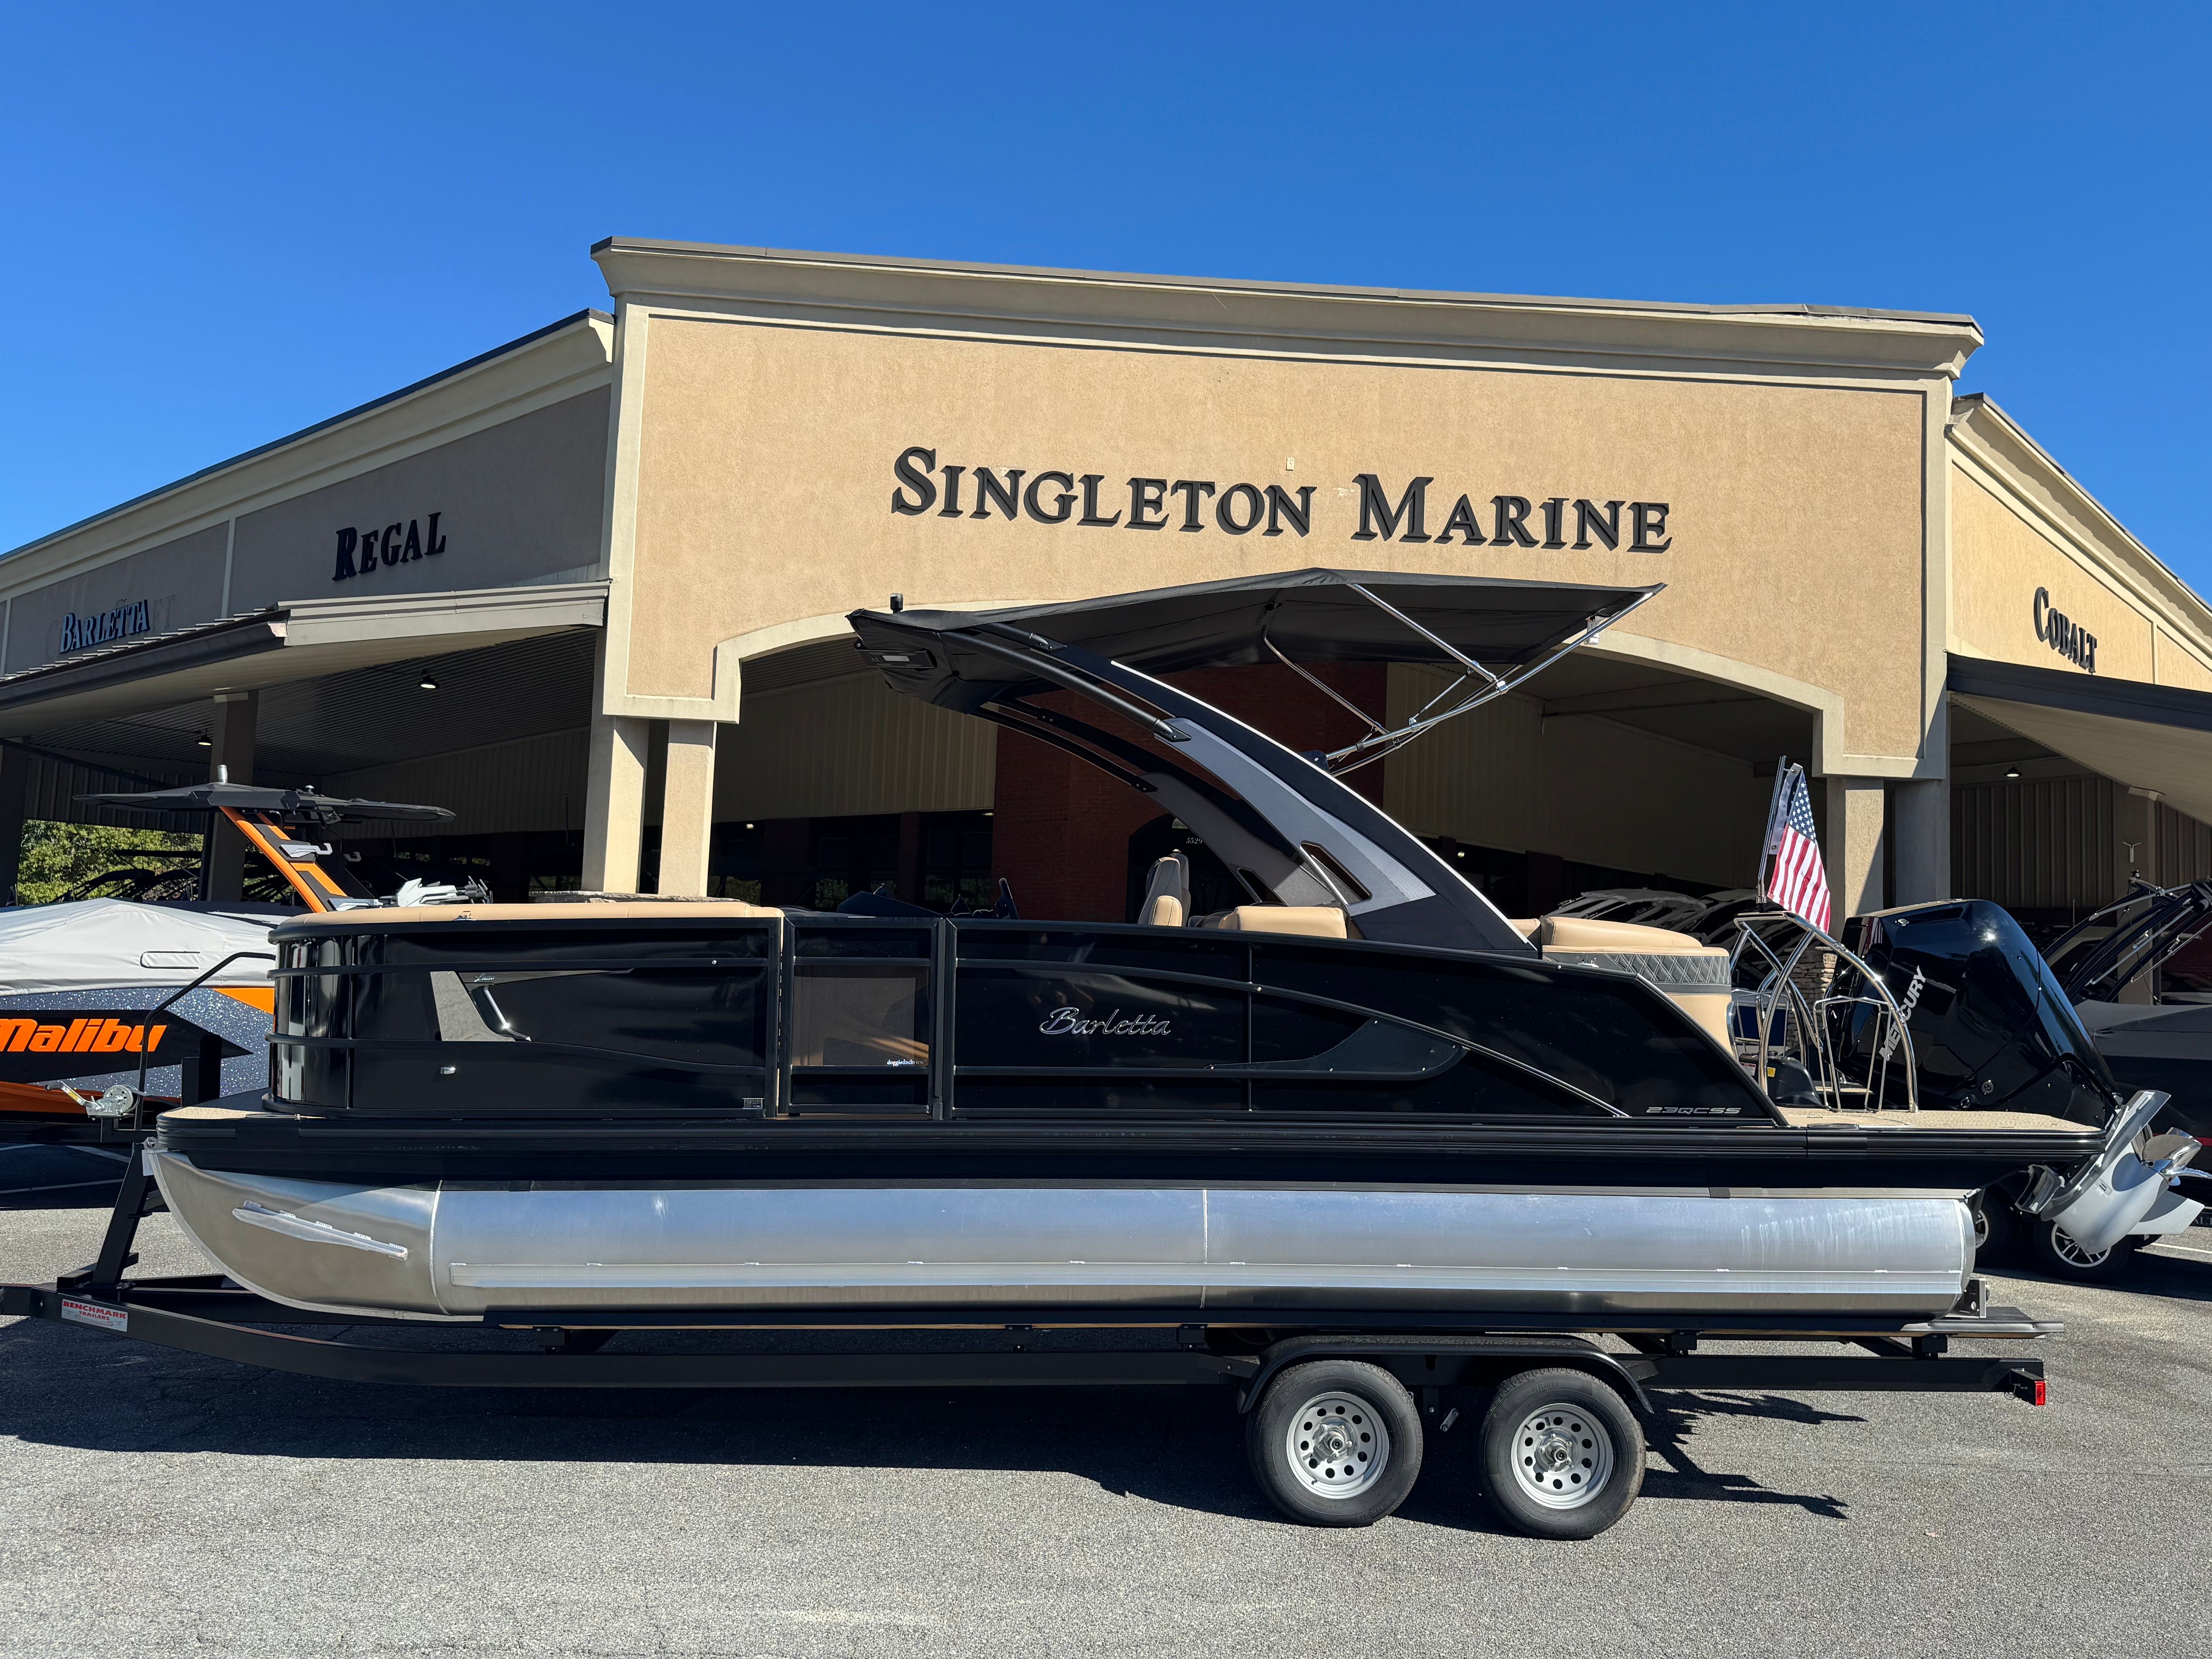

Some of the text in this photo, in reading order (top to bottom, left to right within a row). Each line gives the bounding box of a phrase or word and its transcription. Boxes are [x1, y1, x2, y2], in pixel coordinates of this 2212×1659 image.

[891, 447, 1673, 554] SINGLETON MARINE
[332, 512, 447, 581] REGAL
[59, 599, 150, 654] BARLETTA
[2033, 587, 2097, 675] COBALT
[0, 1018, 167, 1052] Malibu
[1039, 1007, 1171, 1035] Barletta
[63, 1300, 126, 1319] BENCHMARK
[79, 1310, 110, 1321] TRAILERS
